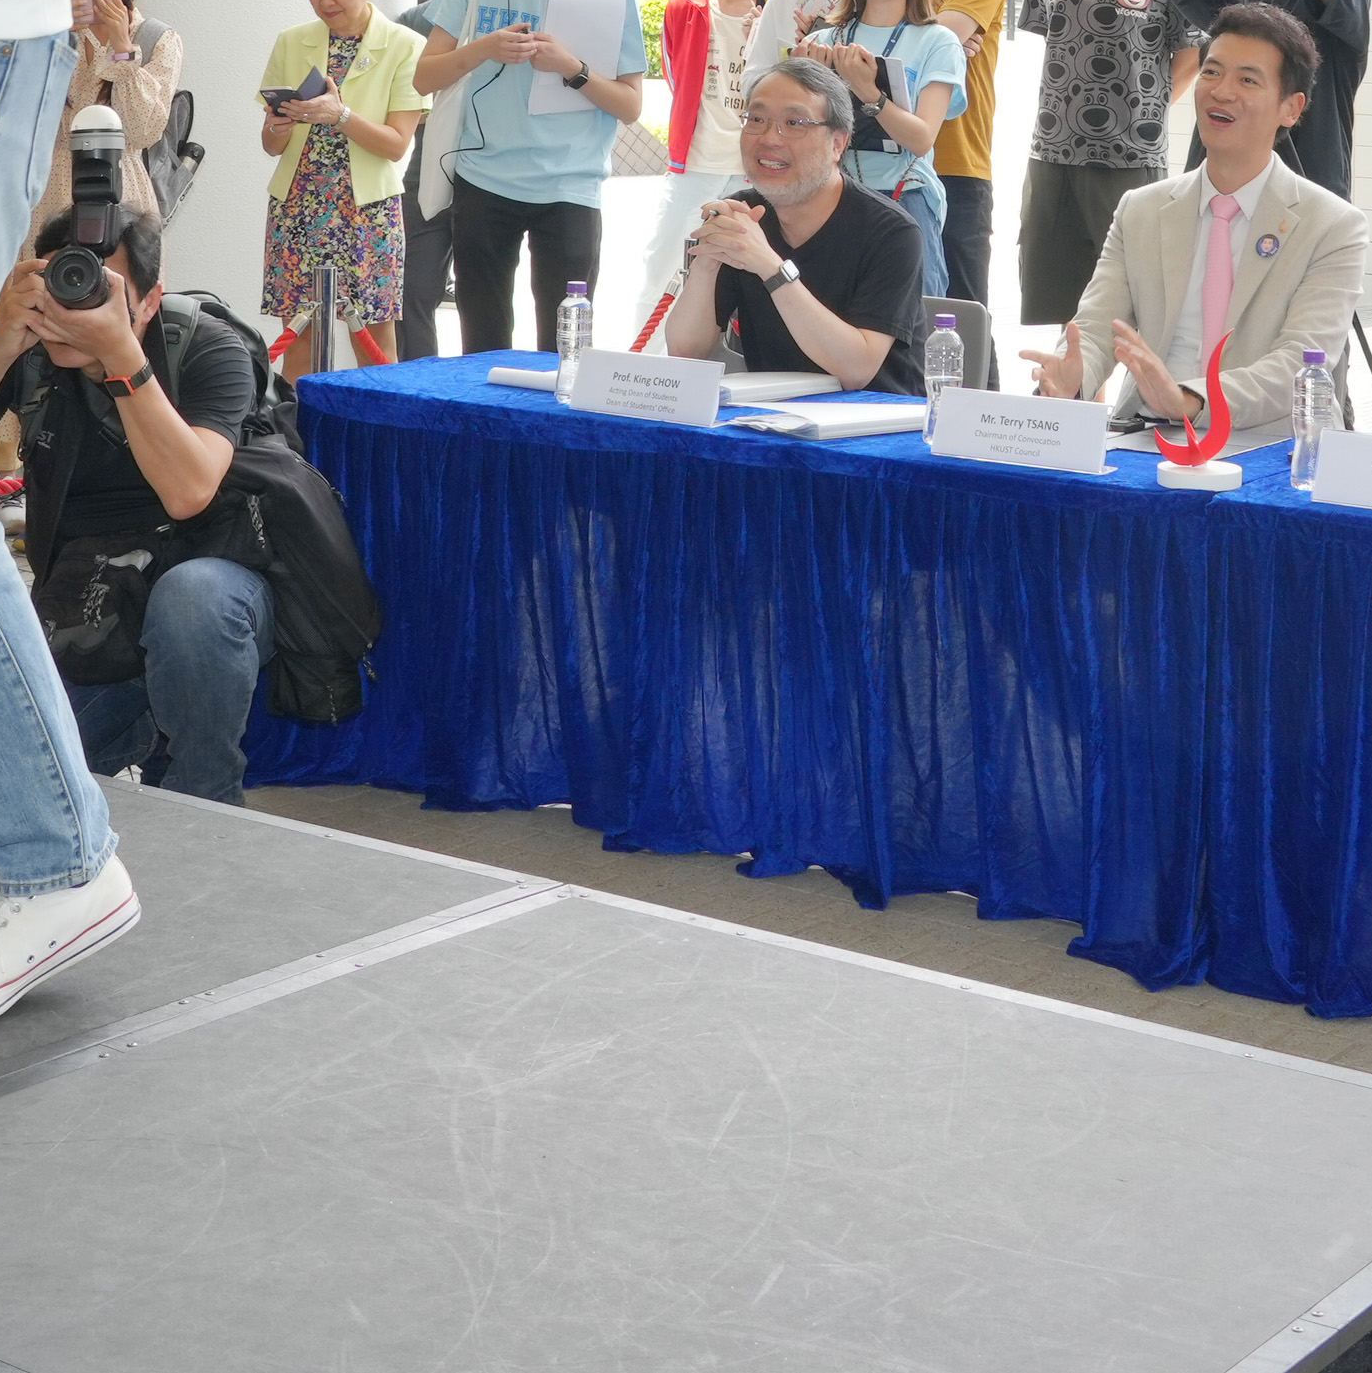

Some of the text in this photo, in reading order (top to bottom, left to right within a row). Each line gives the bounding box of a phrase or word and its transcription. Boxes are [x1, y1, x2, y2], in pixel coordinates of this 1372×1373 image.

[612, 371, 681, 389] Prof. King CHOW
[609, 386, 678, 402] Acting Dean of Students
[606, 398, 621, 406] Dean
[622, 399, 629, 407] of
[658, 403, 675, 414] Office
[980, 414, 1059, 432] Mr. Terry TSANG
[974, 430, 1061, 447] Chairman of Convocation
[990, 445, 1040, 457] HKUST Council
